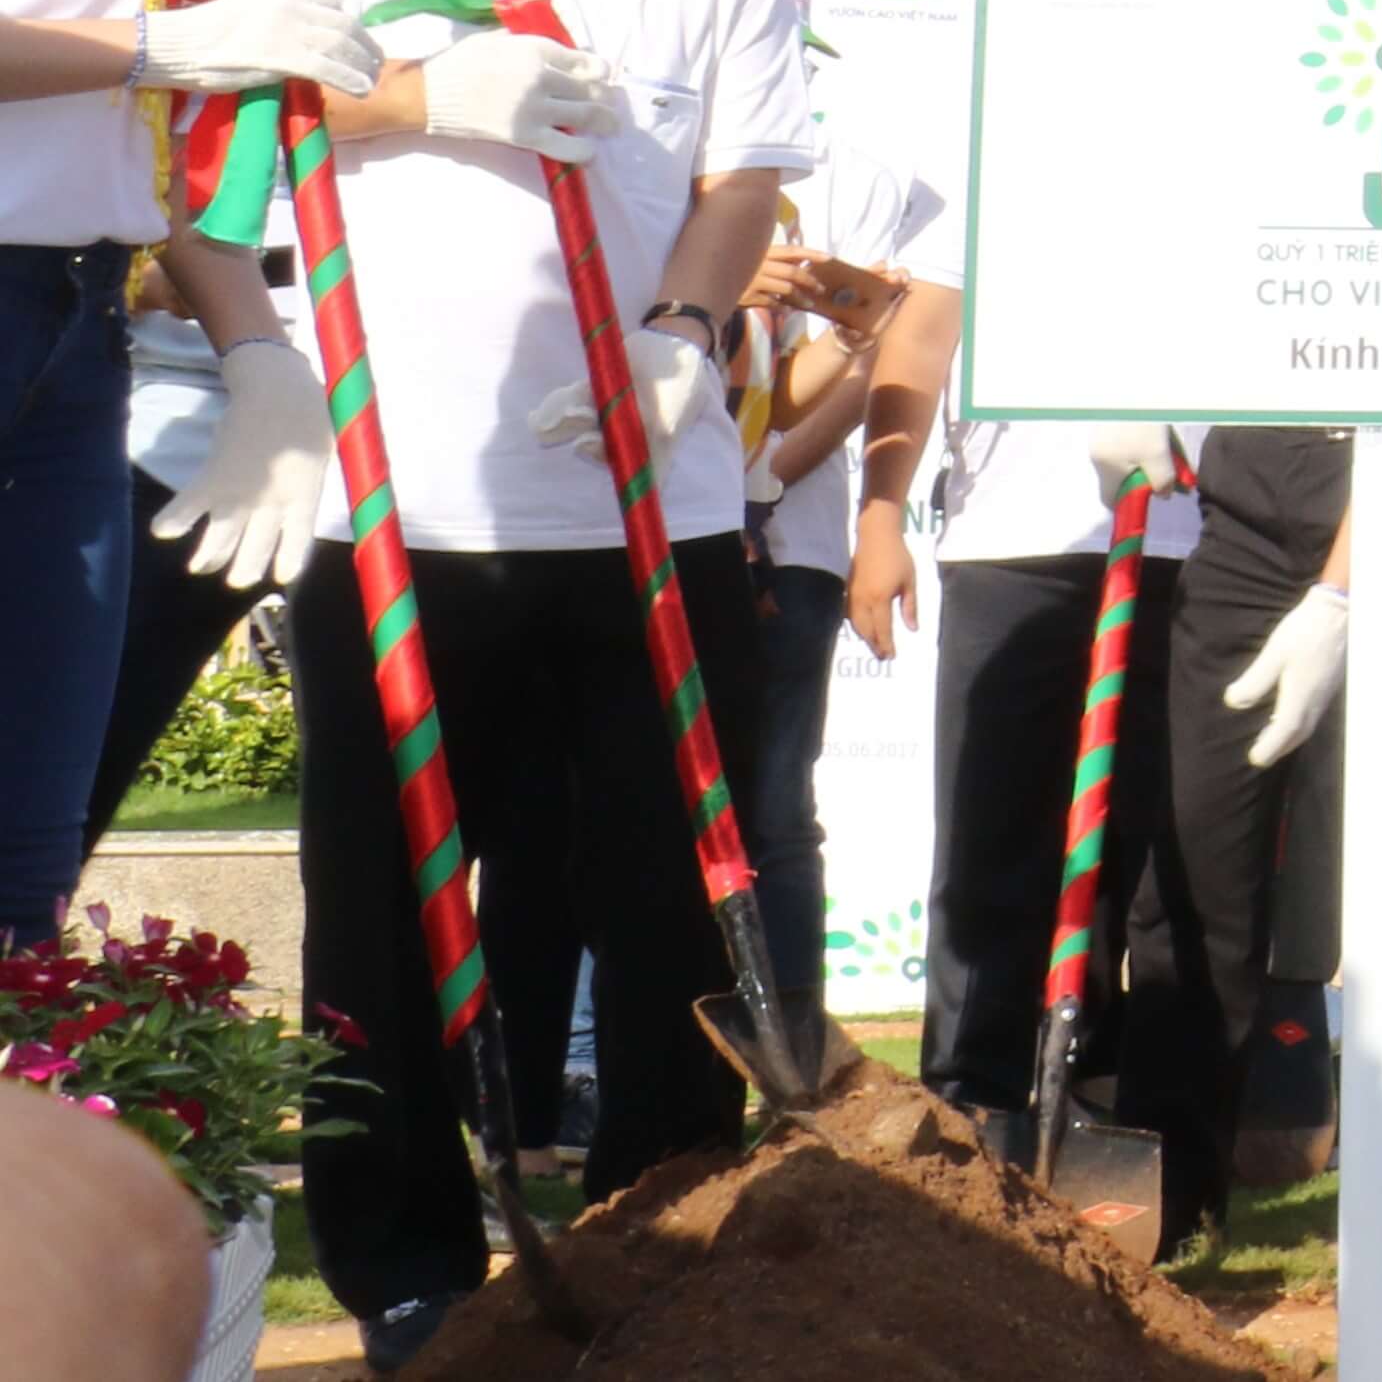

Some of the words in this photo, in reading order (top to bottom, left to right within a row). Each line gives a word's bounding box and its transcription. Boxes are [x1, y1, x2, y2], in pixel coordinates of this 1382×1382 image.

[1316, 244, 1324, 262] 1
[1256, 278, 1333, 306] CHO
[1289, 336, 1380, 371] Kính
